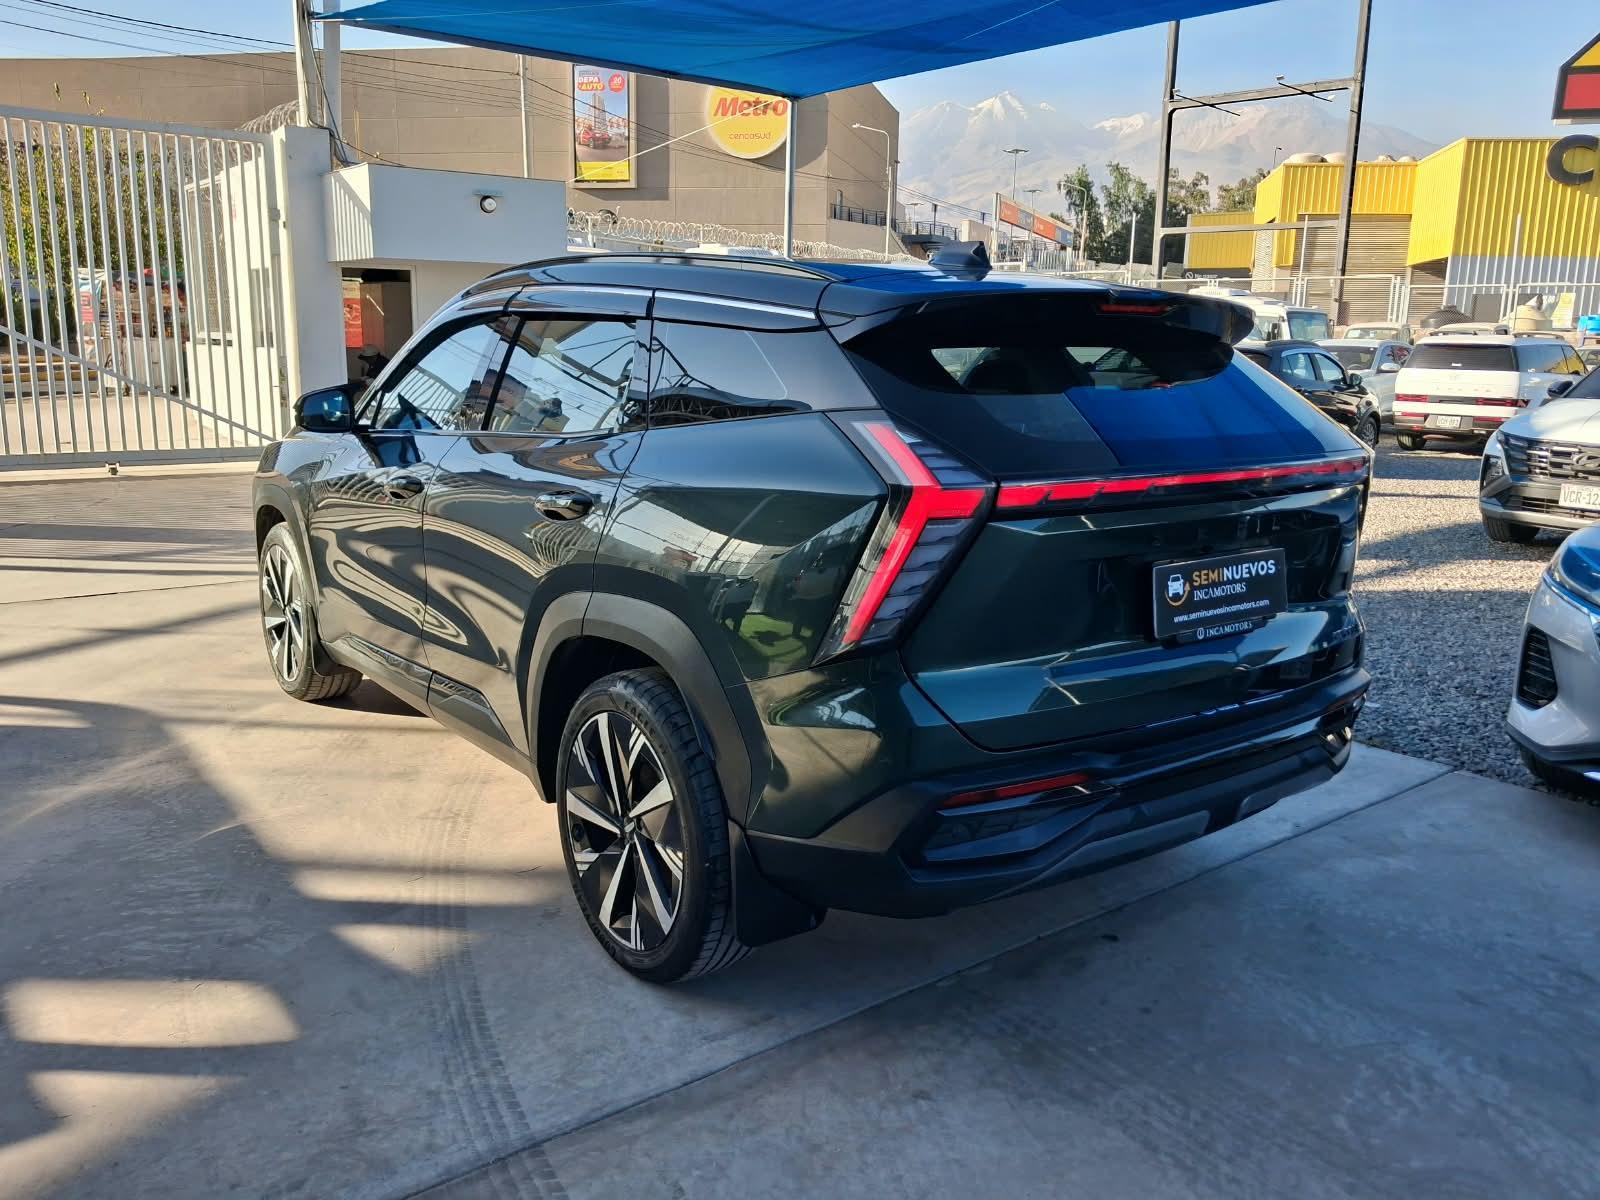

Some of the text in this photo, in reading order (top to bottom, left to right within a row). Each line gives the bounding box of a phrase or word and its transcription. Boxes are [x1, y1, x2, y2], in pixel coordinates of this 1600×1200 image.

[713, 96, 788, 116] Metro
[728, 131, 771, 140] cencosud
[1563, 490, 1600, 506] VCR-12
[1192, 559, 1276, 586] SEMINUEVOS
[1194, 582, 1247, 601] INCAMOTORS
[1173, 599, 1270, 623] www.seminuevosincamotors.com
